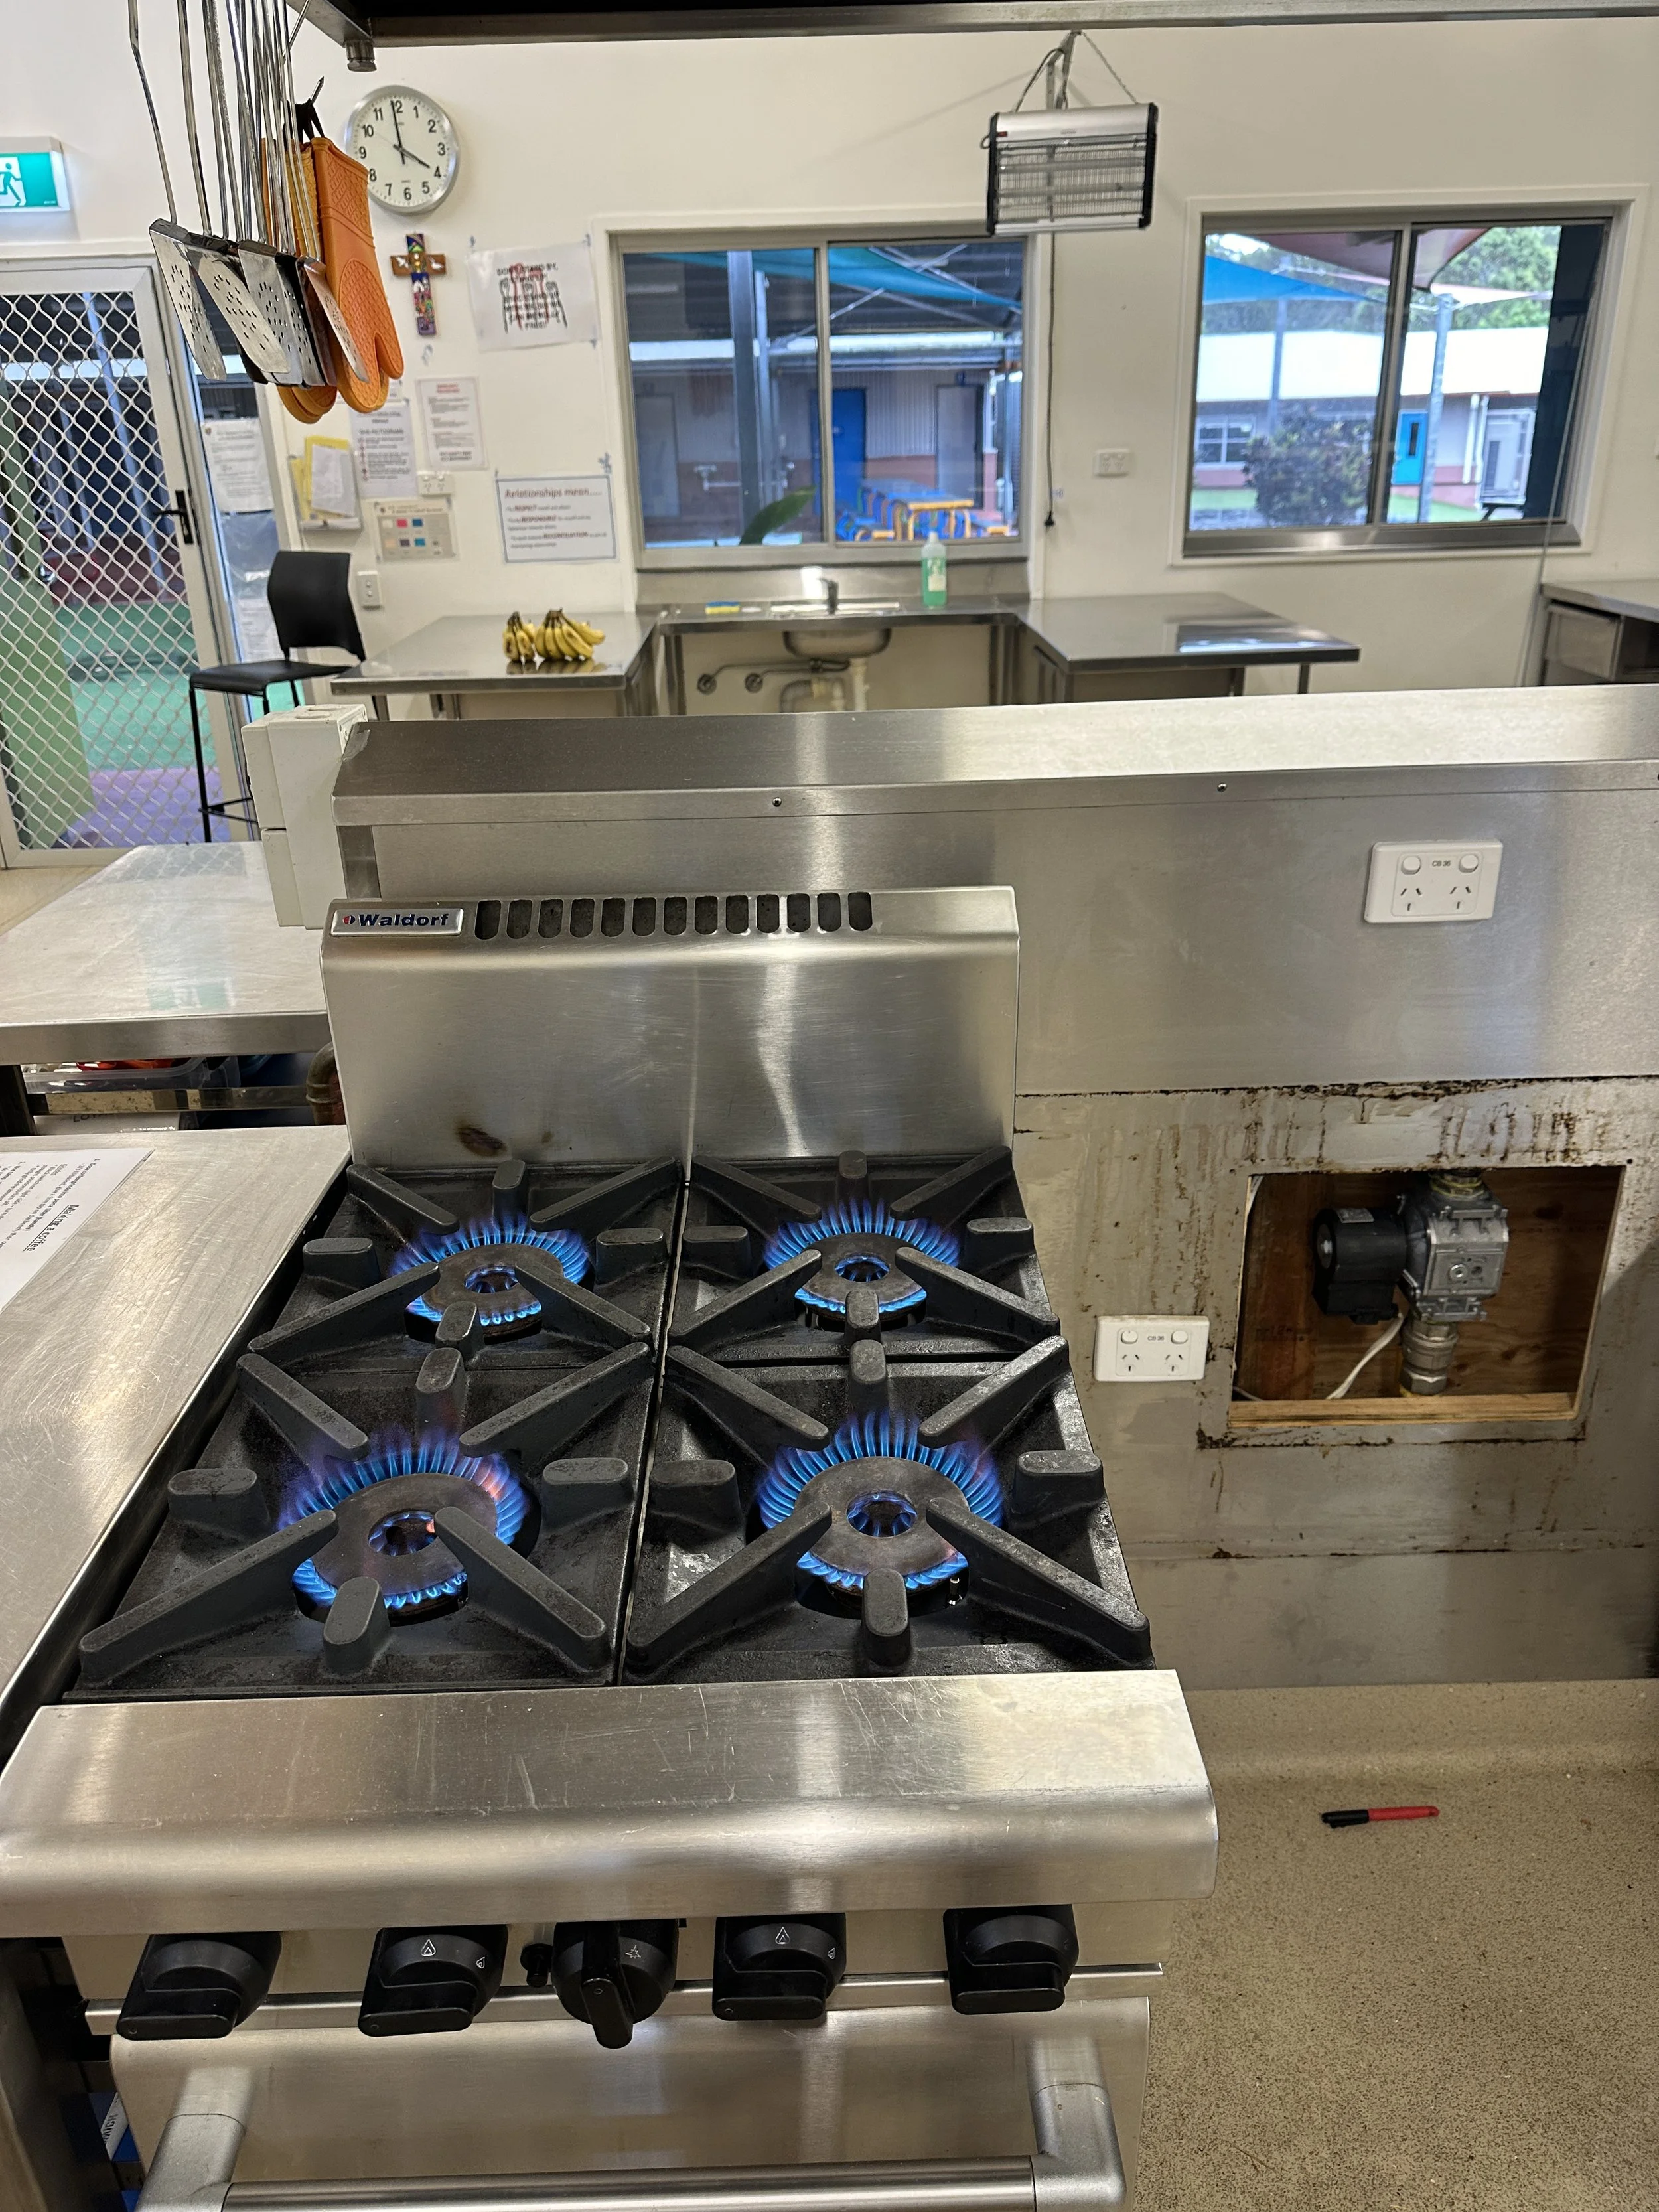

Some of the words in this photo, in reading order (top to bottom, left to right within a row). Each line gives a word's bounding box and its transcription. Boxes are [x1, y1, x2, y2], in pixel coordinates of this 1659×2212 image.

[373, 107, 384, 121] 11
[413, 106, 419, 118] 1
[362, 125, 374, 138] 10
[428, 119, 437, 133] 2
[358, 146, 367, 159] 9
[437, 142, 446, 156] 3
[369, 169, 377, 181] 8
[434, 166, 441, 179] 4
[385, 183, 392, 196] 7
[403, 187, 412, 200] 6
[421, 181, 430, 194] 5
[505, 487, 563, 500] Relationships
[358, 913, 449, 926] Waldorf
[49, 1205, 79, 1226] Making
[27, 1232, 50, 1252] coffee
